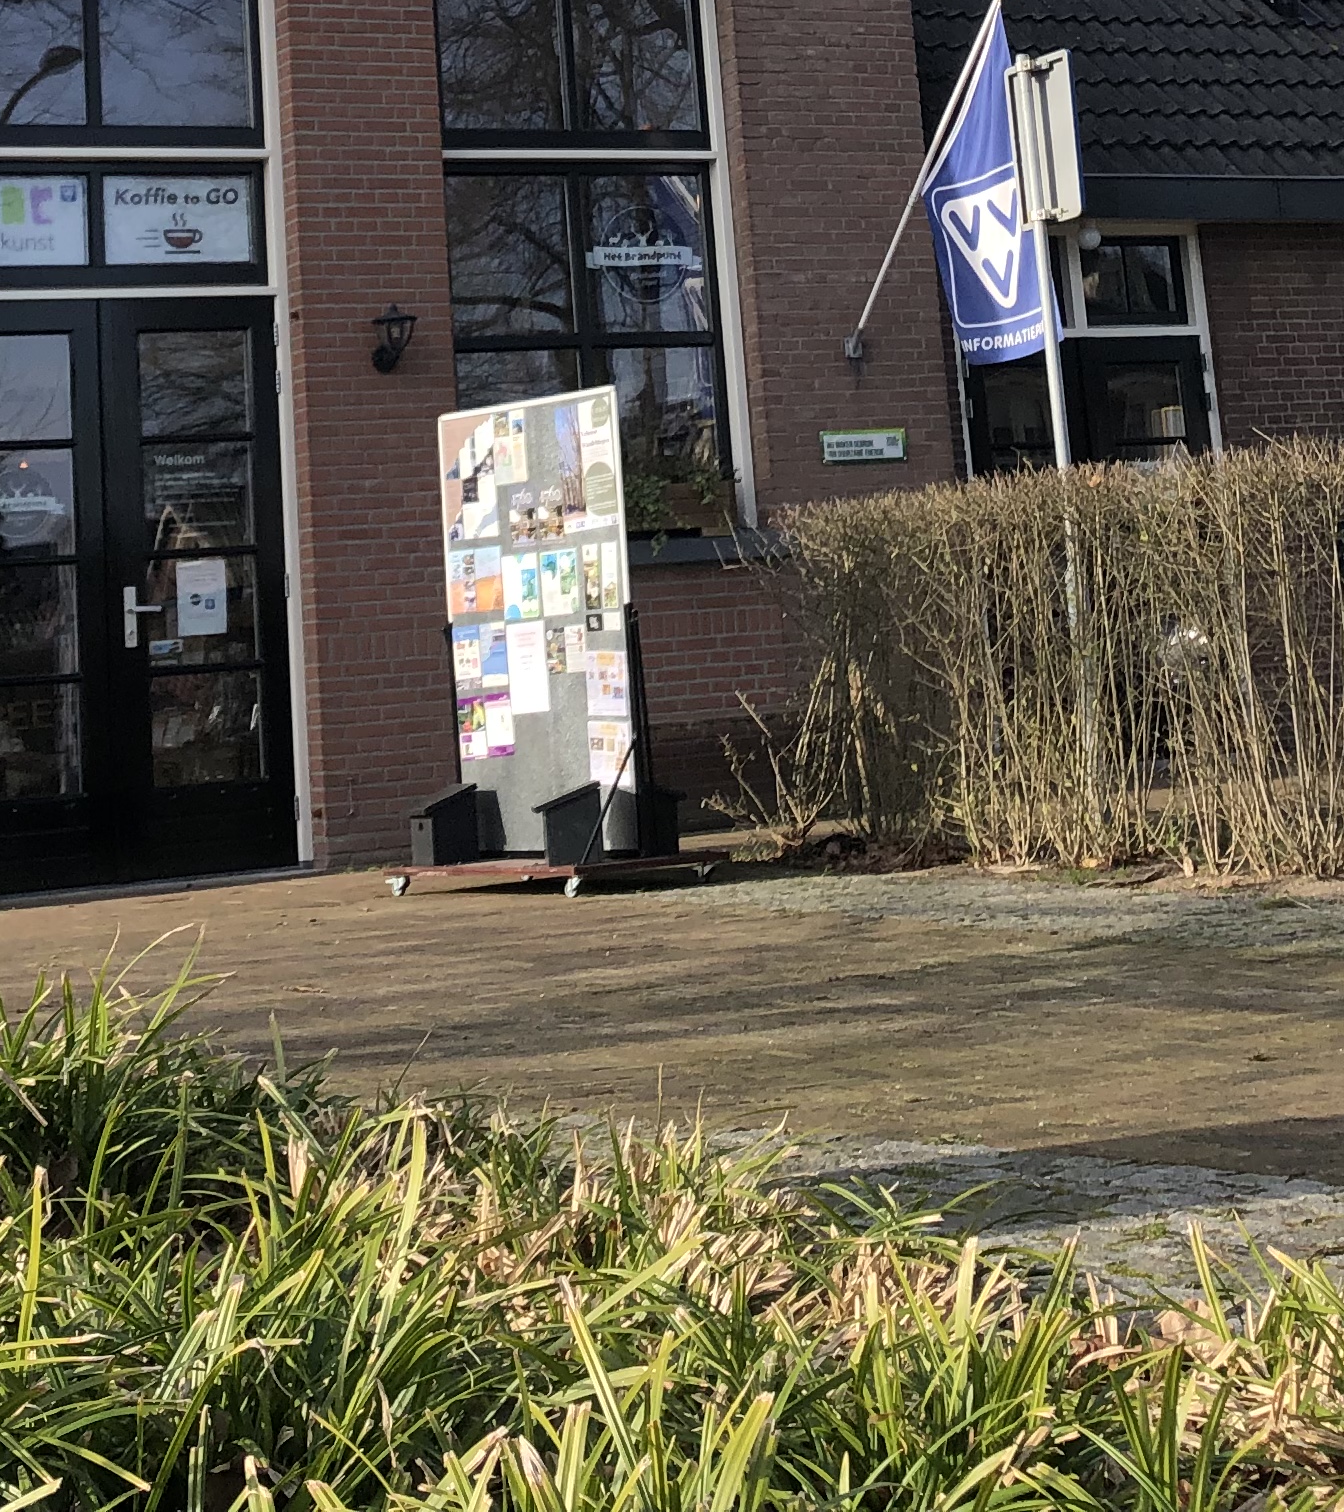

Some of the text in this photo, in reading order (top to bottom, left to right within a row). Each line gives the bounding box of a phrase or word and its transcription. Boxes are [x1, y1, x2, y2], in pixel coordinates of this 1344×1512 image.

[114, 187, 240, 207] Koffie to GO
[0, 232, 56, 252] kunst
[603, 250, 682, 263] Het Brandpunt
[153, 454, 206, 466] Welkom
